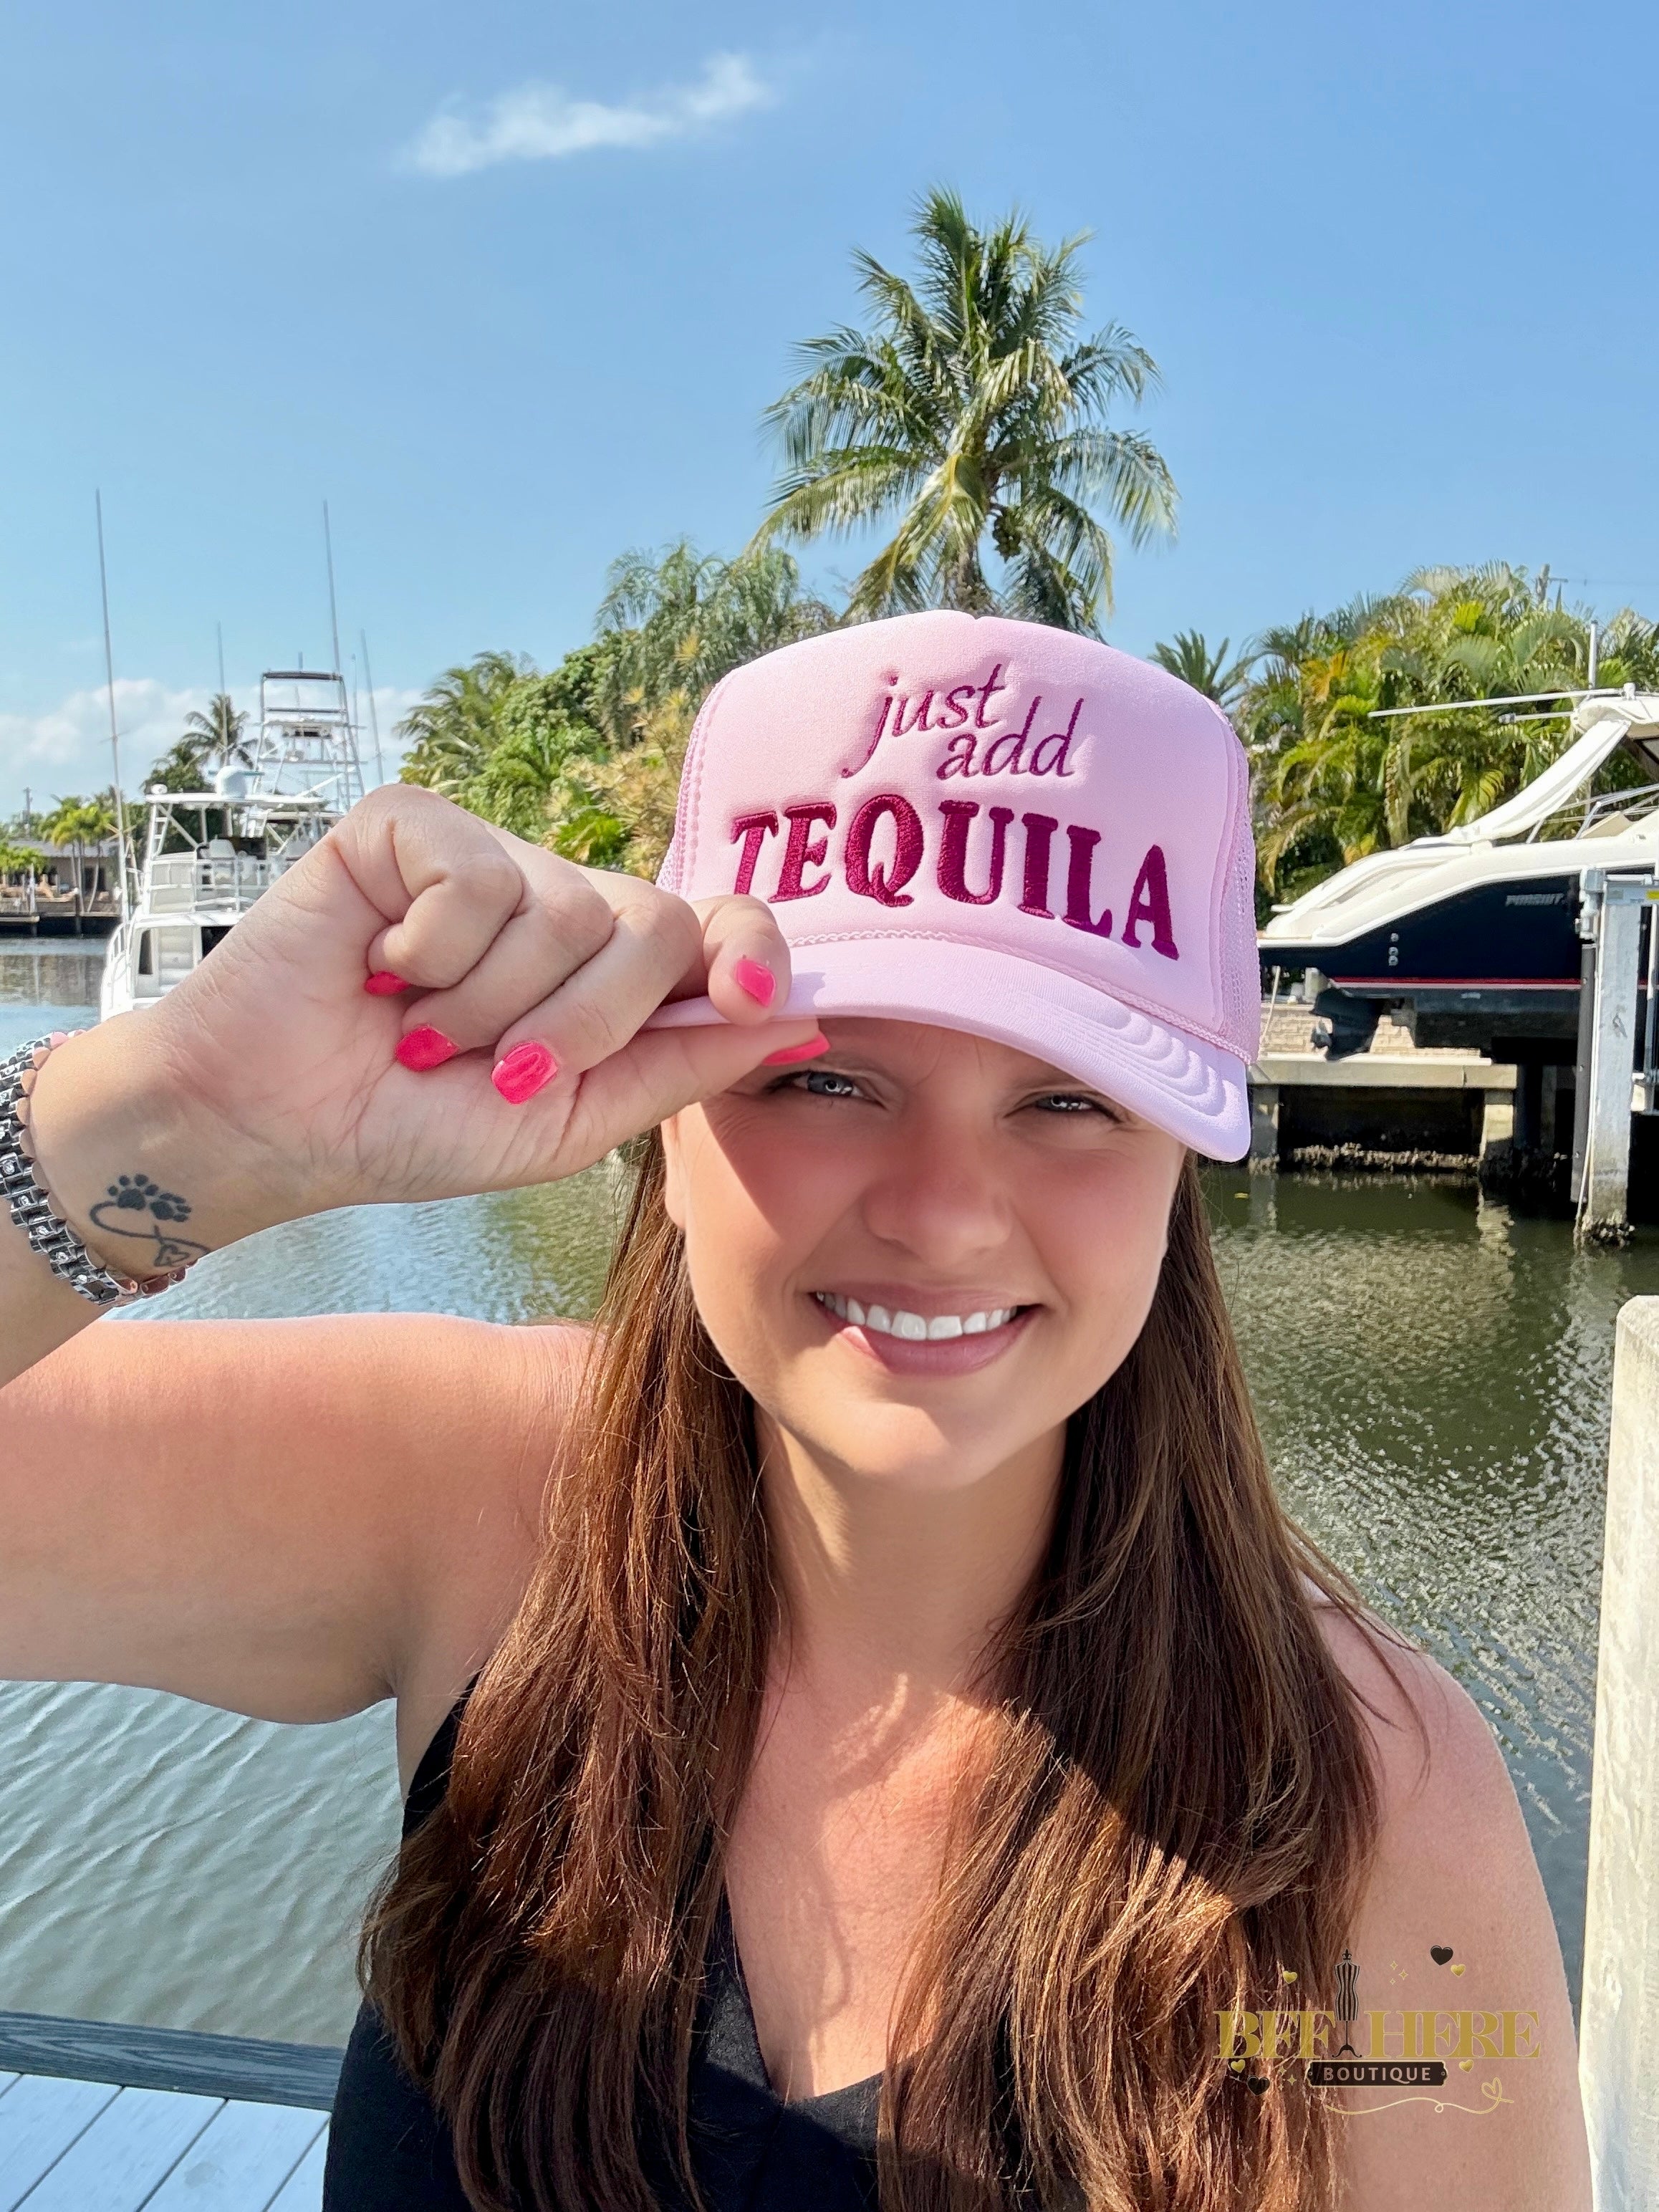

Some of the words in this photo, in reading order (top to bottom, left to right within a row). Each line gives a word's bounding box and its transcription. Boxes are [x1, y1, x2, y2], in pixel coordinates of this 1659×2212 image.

[841, 663, 1006, 779] just
[936, 696, 1084, 781] add
[730, 793, 1179, 961] TEQUILA
